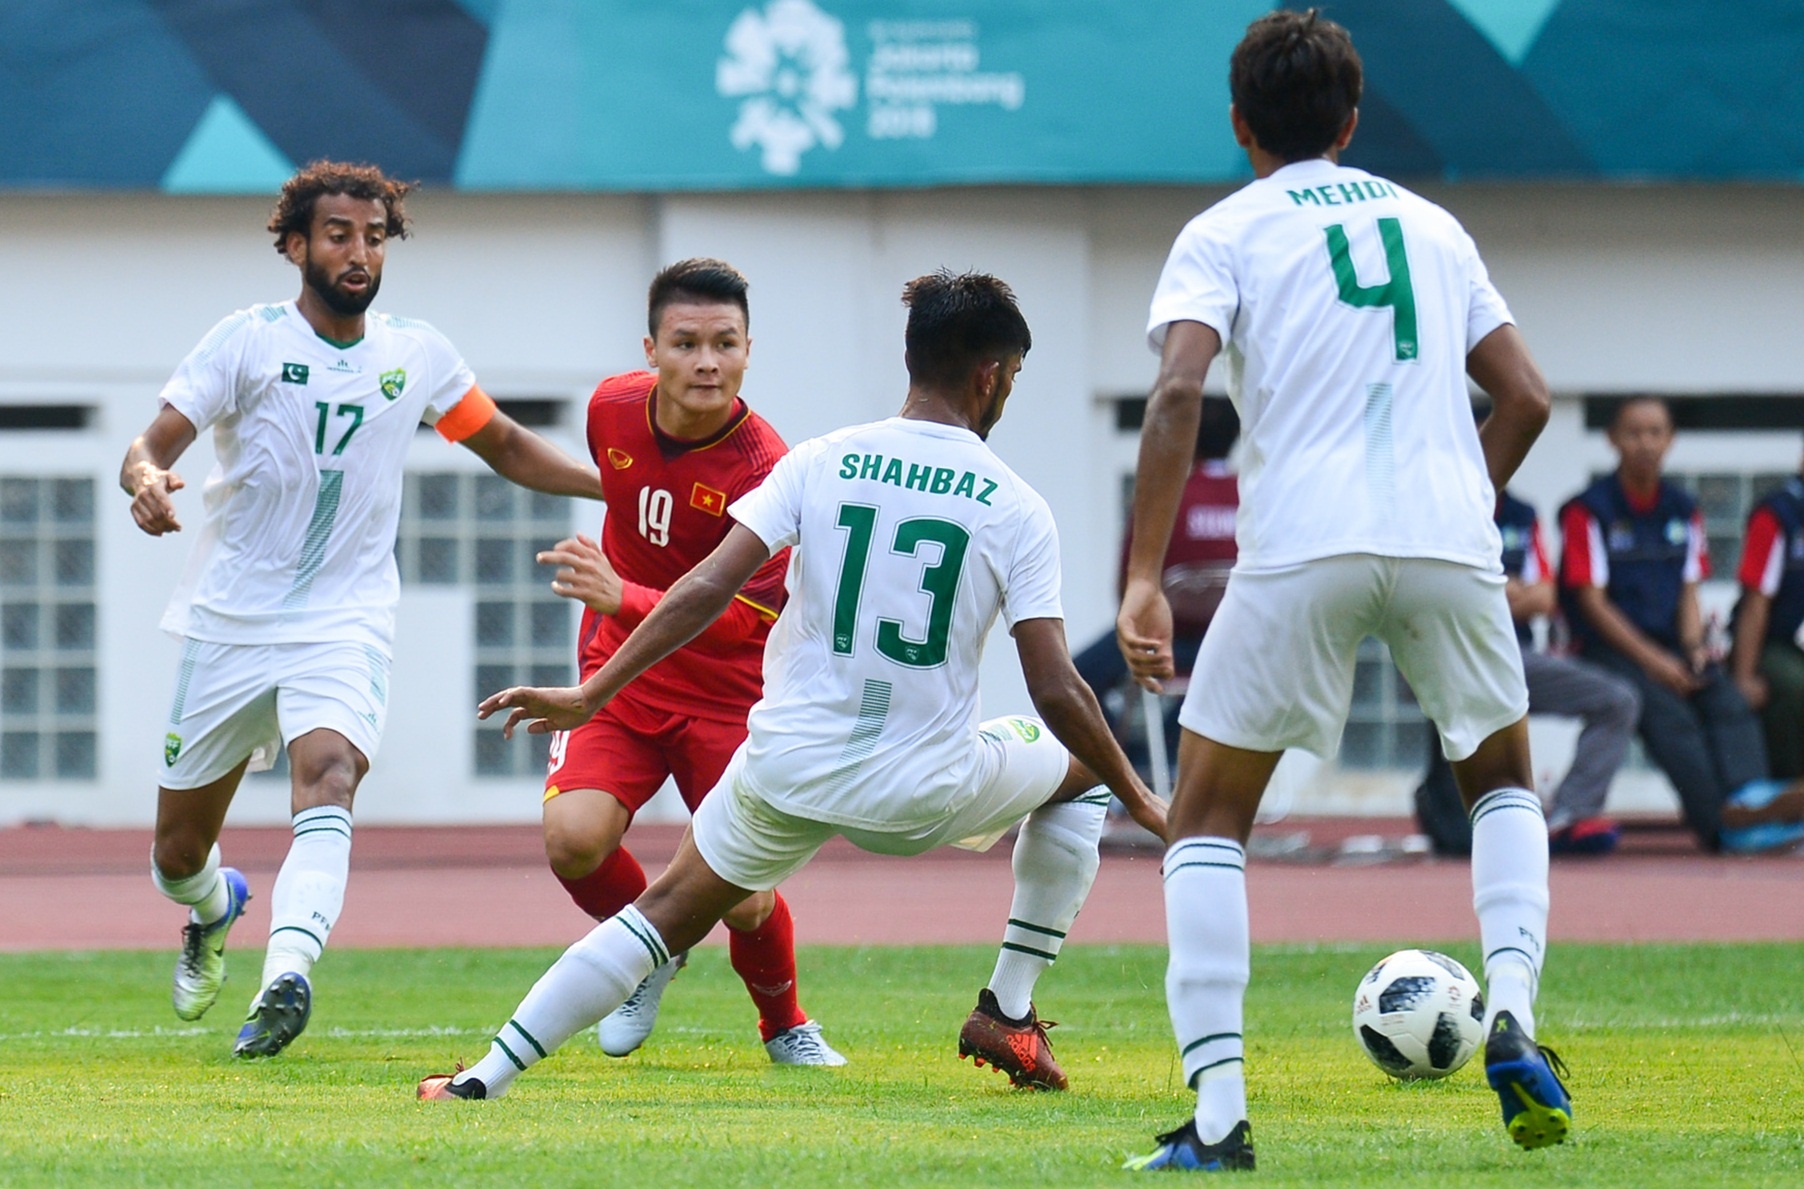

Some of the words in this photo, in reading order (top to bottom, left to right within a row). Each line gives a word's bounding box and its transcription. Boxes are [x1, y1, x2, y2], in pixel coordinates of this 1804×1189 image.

[1286, 180, 1399, 207] MEHDI
[1321, 216, 1420, 363] 4
[315, 401, 364, 456] 17
[839, 454, 998, 507] SHAHBAZ
[638, 485, 673, 547] 19
[832, 500, 973, 670] 13
[1006, 1034, 1036, 1072] adidas
